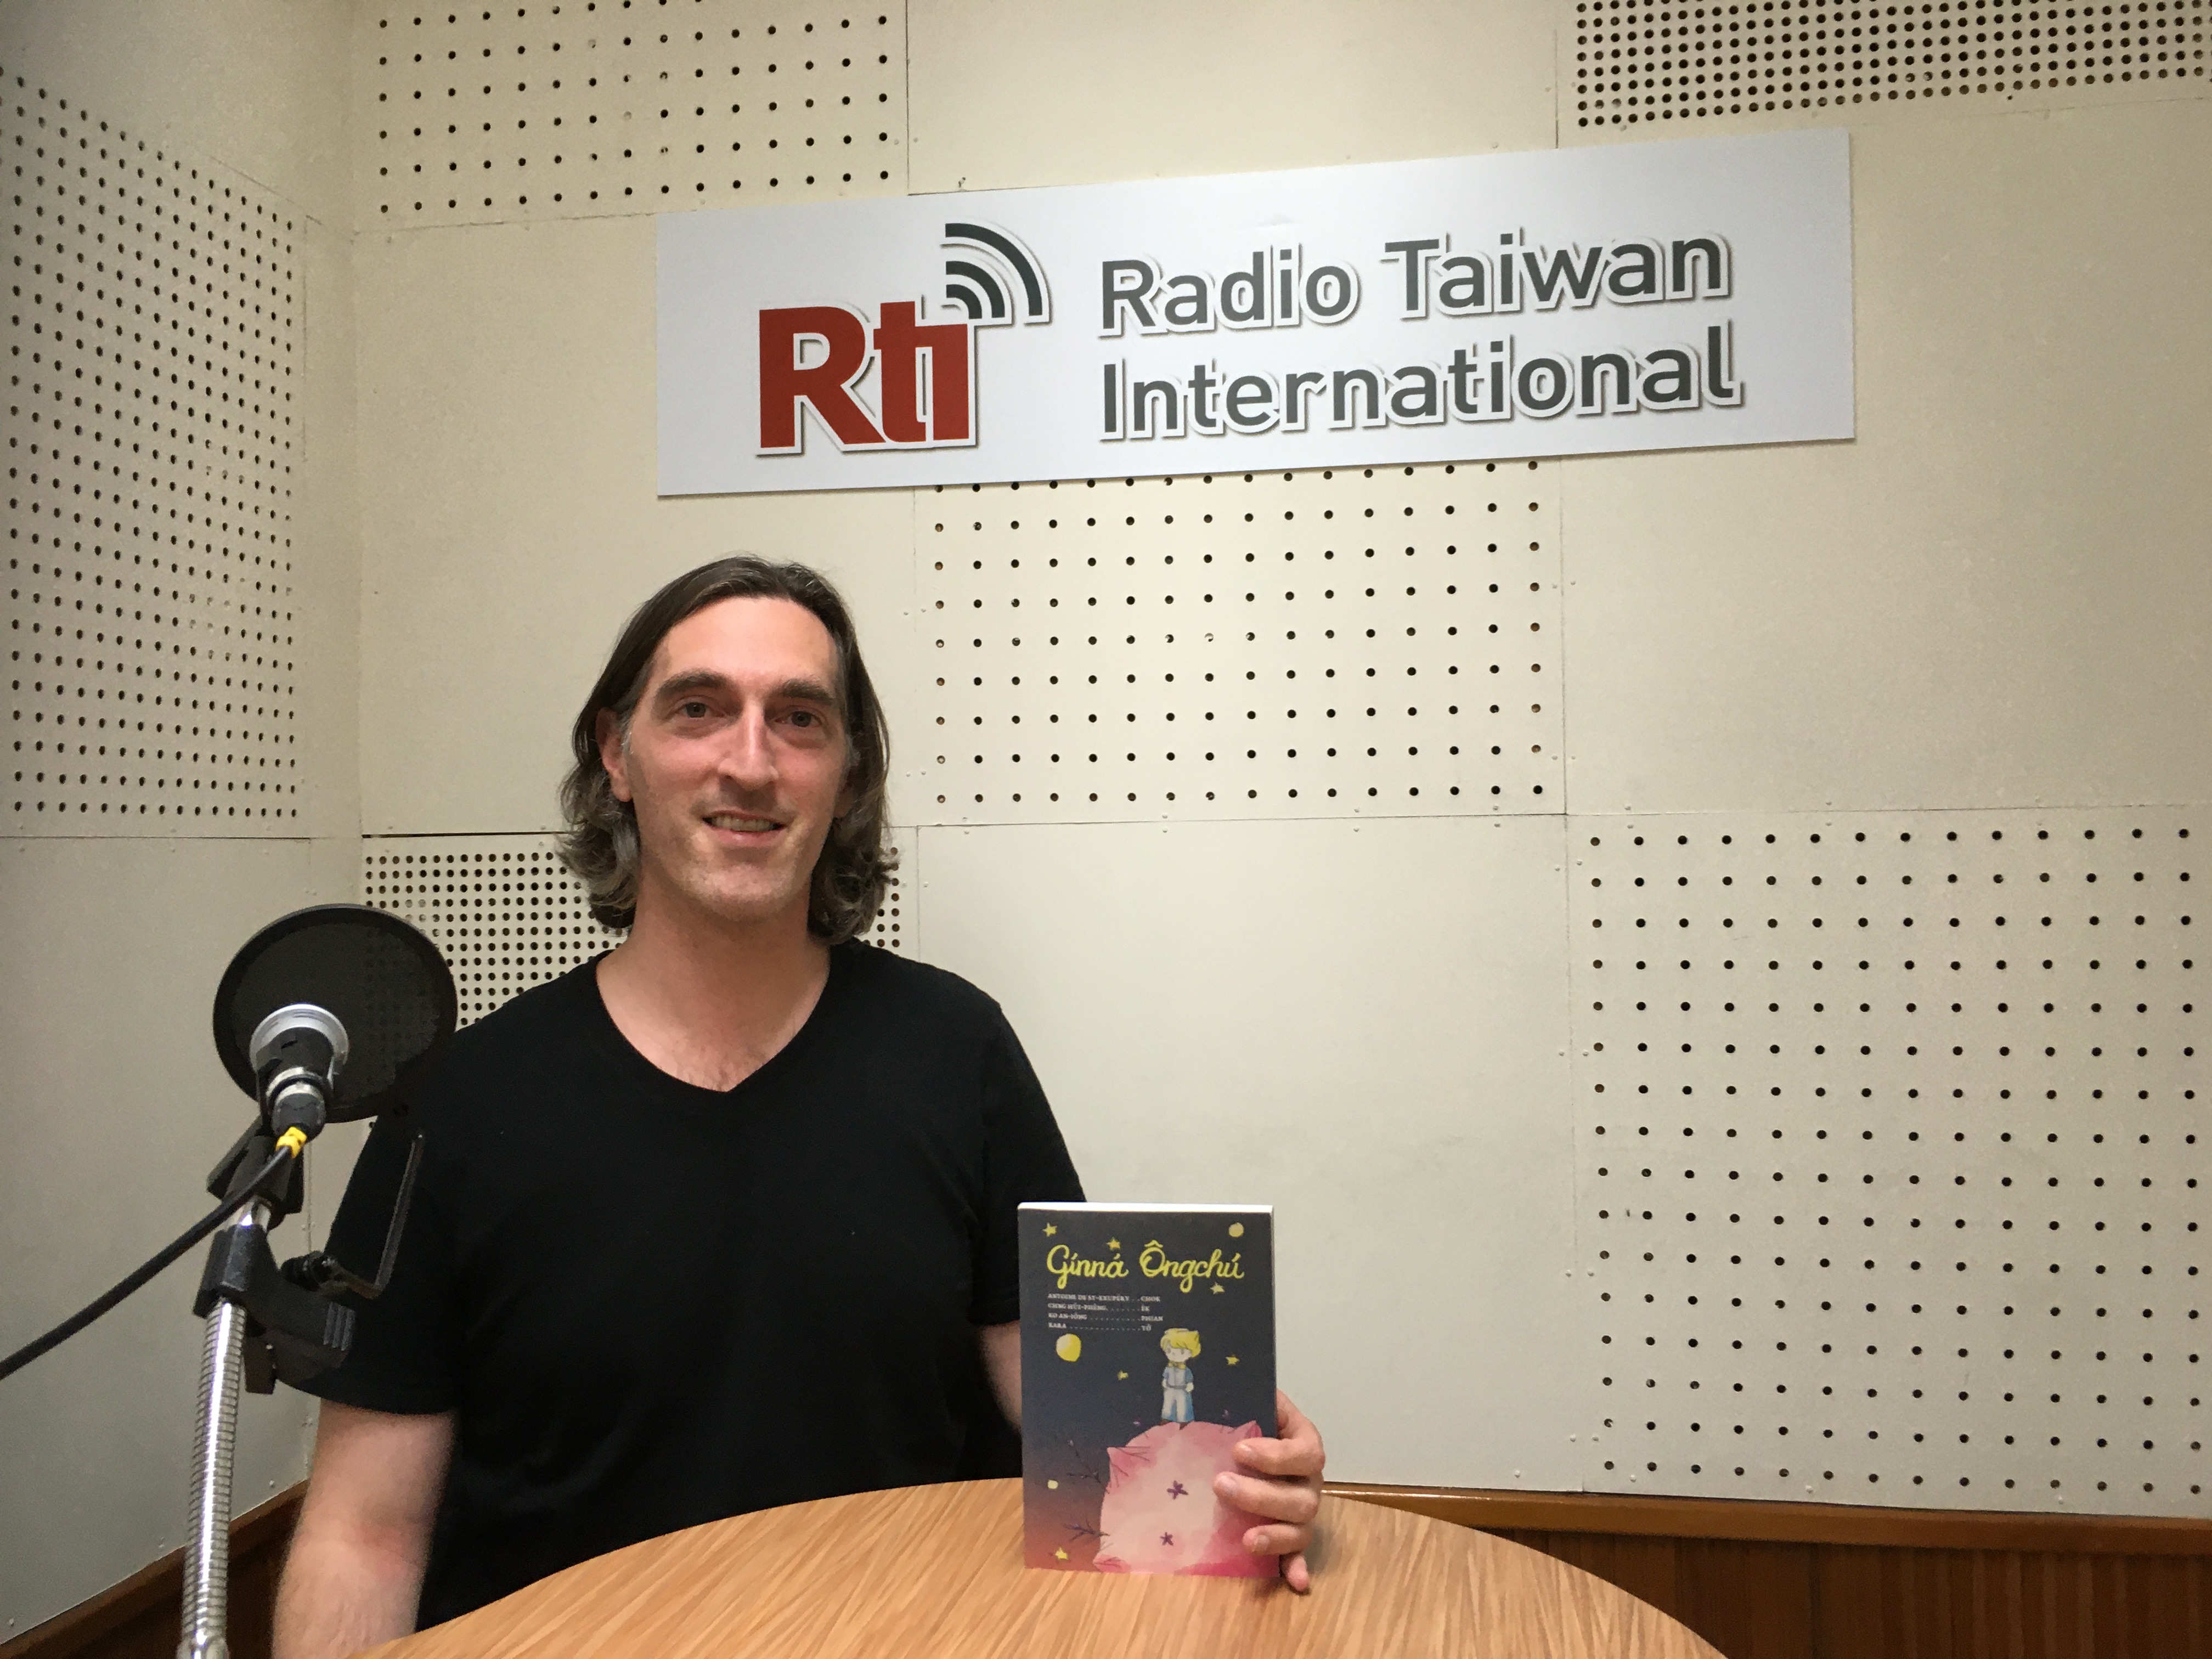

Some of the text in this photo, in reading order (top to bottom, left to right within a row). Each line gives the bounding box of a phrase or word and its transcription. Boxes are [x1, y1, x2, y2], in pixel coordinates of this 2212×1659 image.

[1102, 232, 1724, 329] Radio Taiwan
[759, 300, 970, 449] Rti
[1103, 325, 1735, 433] International
